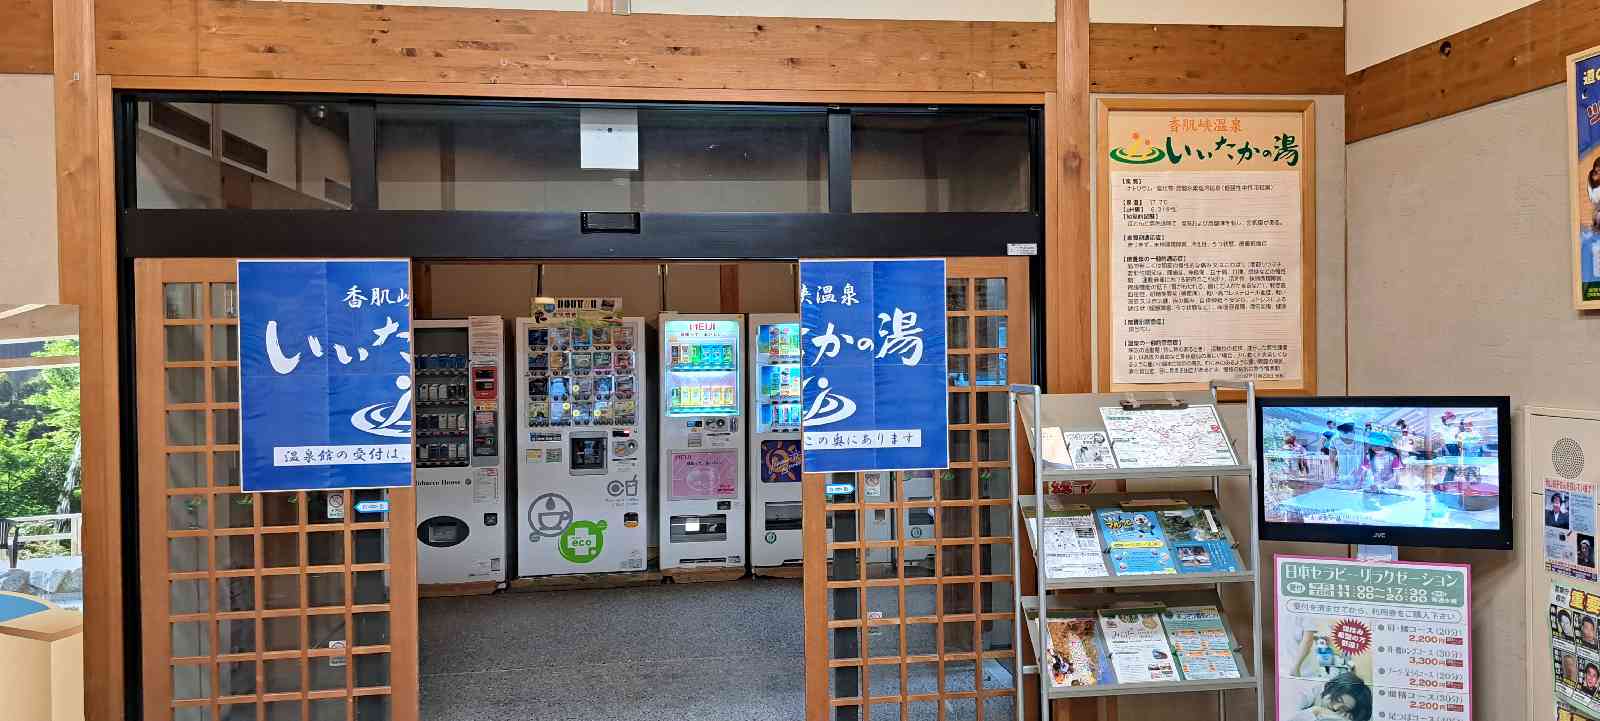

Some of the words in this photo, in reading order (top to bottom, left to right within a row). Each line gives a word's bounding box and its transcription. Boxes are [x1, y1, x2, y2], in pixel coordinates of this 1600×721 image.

[1168, 118, 1243, 133] 香肌峡温泉
[1165, 133, 1299, 166] いいたかの湯
[572, 537, 592, 547] eco
